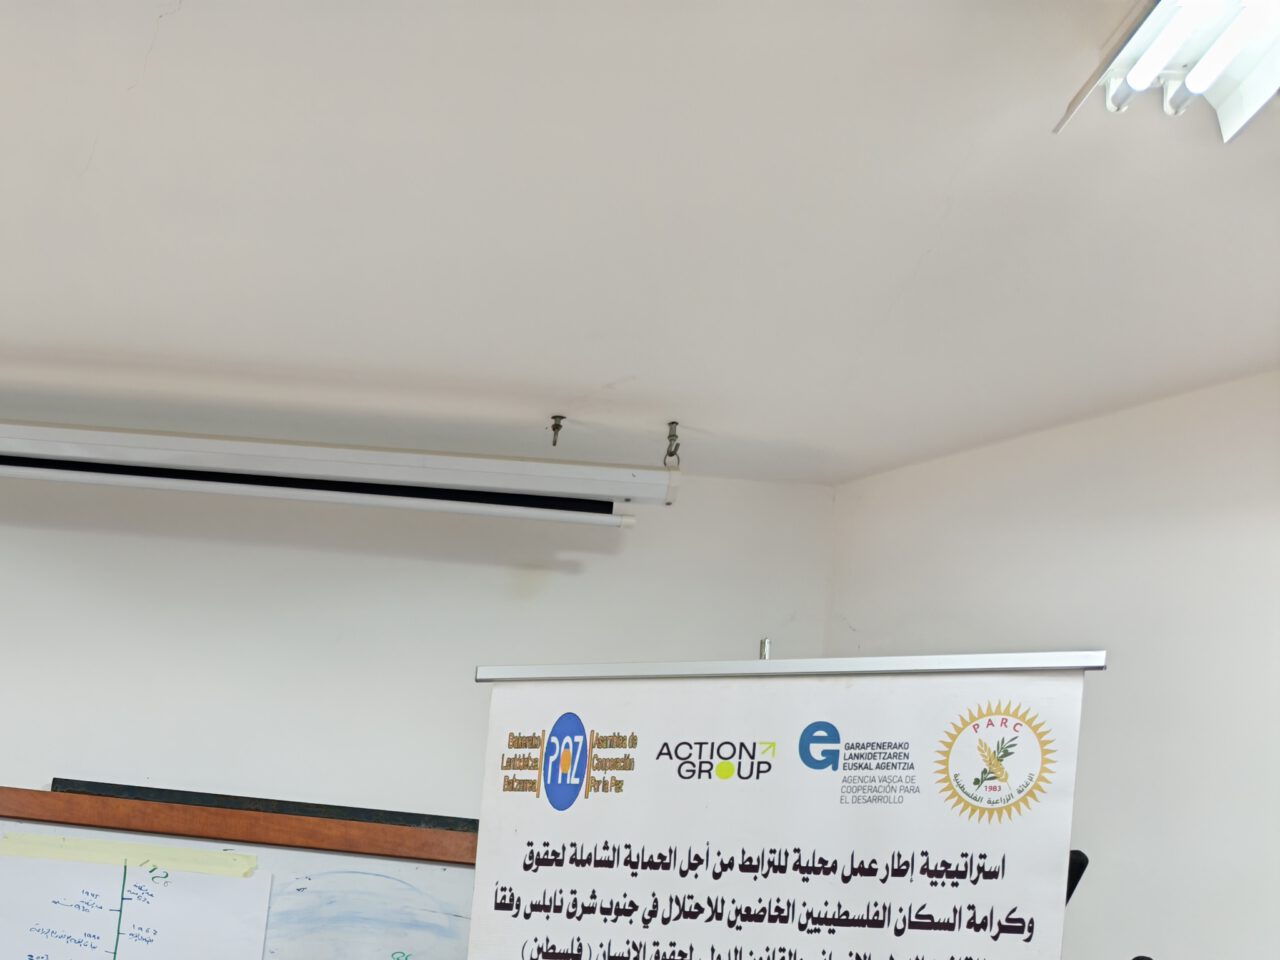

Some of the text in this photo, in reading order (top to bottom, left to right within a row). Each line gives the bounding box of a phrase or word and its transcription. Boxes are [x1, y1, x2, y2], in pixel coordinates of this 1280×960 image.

[972, 717, 1023, 734] PARC
[629, 732, 638, 749] de
[655, 741, 757, 761] ACTION
[844, 741, 910, 751] GARAPENERAKO
[547, 735, 584, 784] PAZ
[842, 762, 915, 771] EUSKAL AGENTZIA
[843, 752, 910, 761] LANKIDETZAREN
[677, 760, 772, 780] GROUP
[841, 775, 916, 784] AGENCIA VASCA DE
[610, 776, 624, 792] Paz
[840, 783, 921, 794] COOPERACIÓN PARA
[839, 795, 904, 804] EL DESARROLLO
[523, 840, 1006, 888] استراتيجية إطار عمل محلية للترابط من أجل الحماية الشاملة لحقوق
[523, 889, 564, 920] نابلس
[566, 889, 597, 921] شرق
[599, 892, 639, 925] جنوب
[641, 891, 659, 928] في
[661, 892, 725, 925] للاحتلال
[727, 897, 795, 931] الخاضعين
[798, 900, 891, 934] الفلسطينيين
[894, 903, 962, 937] السكان
[966, 904, 1035, 943] وكرامة
